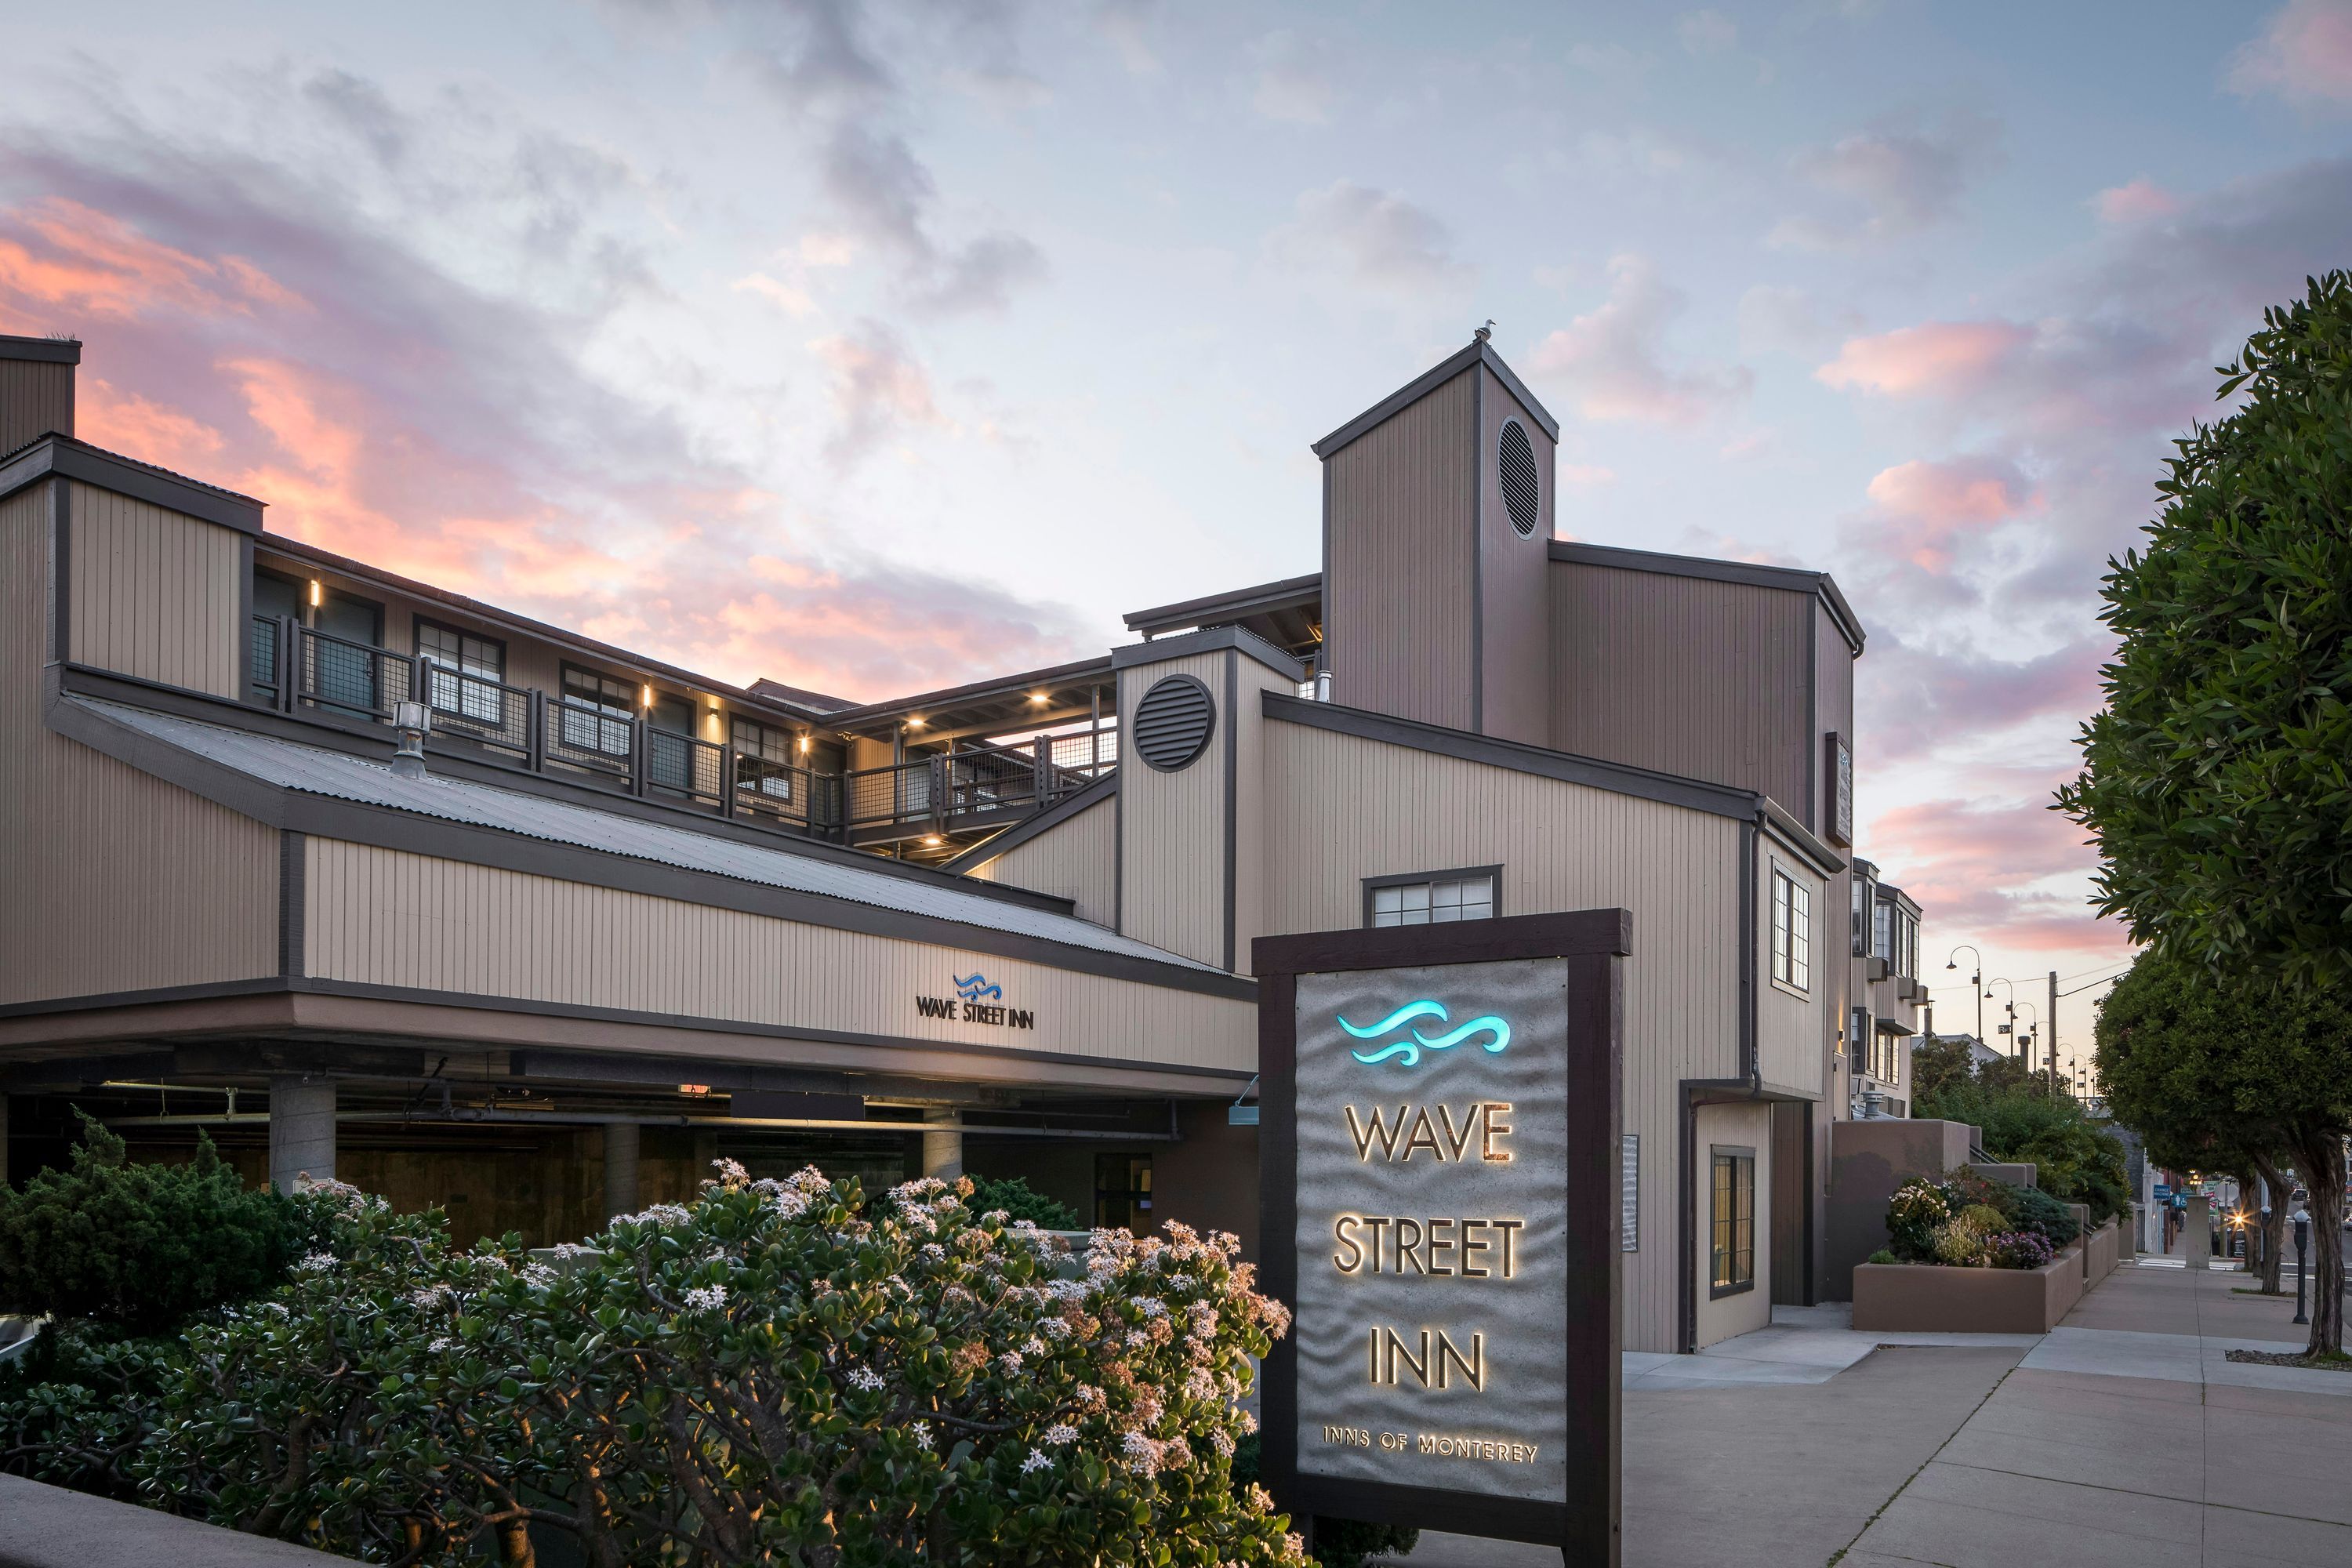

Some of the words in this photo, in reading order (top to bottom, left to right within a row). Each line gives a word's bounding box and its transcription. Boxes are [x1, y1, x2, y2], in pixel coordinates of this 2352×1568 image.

[916, 996, 957, 1019] WAVE
[963, 1004, 1006, 1025] STREET
[1008, 1008, 1033, 1029] INN
[1345, 1103, 1513, 1162] WAVE
[1334, 1215, 1525, 1278] STREET
[1370, 1327, 1483, 1392] INN
[1323, 1426, 1370, 1447] INNS
[1380, 1432, 1408, 1450] OF
[1418, 1435, 1537, 1464] MONTEREY
